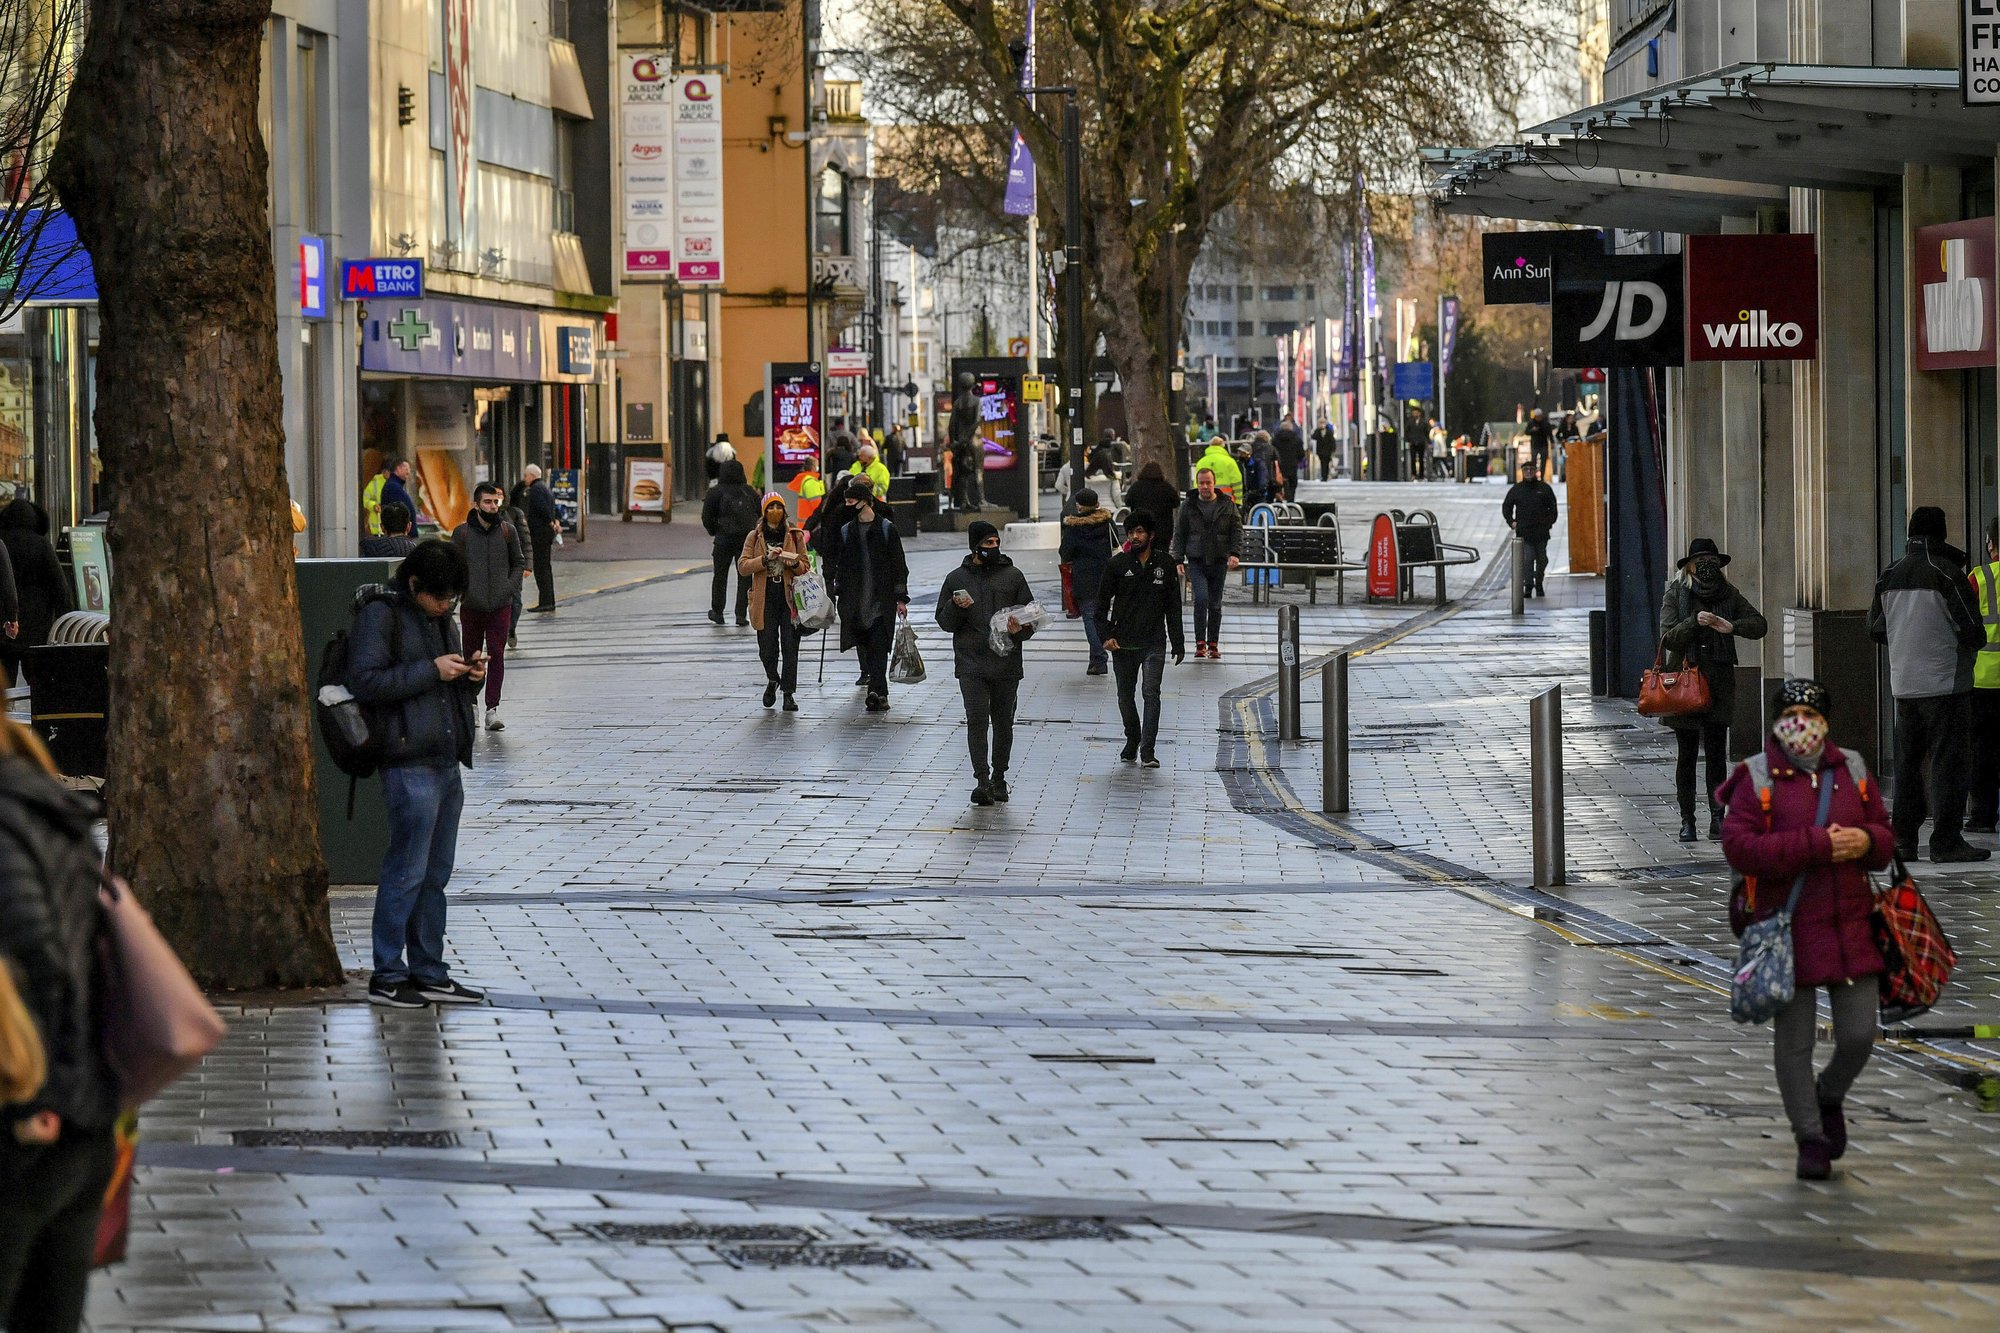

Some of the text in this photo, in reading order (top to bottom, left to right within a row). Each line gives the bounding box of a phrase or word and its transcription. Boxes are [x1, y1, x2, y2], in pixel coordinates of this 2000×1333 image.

[1972, 0, 2000, 15] L
[679, 104, 713, 112] QUEENS
[632, 144, 662, 156] Argos
[347, 265, 415, 292] METRO
[1493, 266, 1521, 279] Ann
[377, 281, 415, 292] BANK
[1579, 281, 1667, 342] JD
[1702, 309, 1803, 348] wilko
